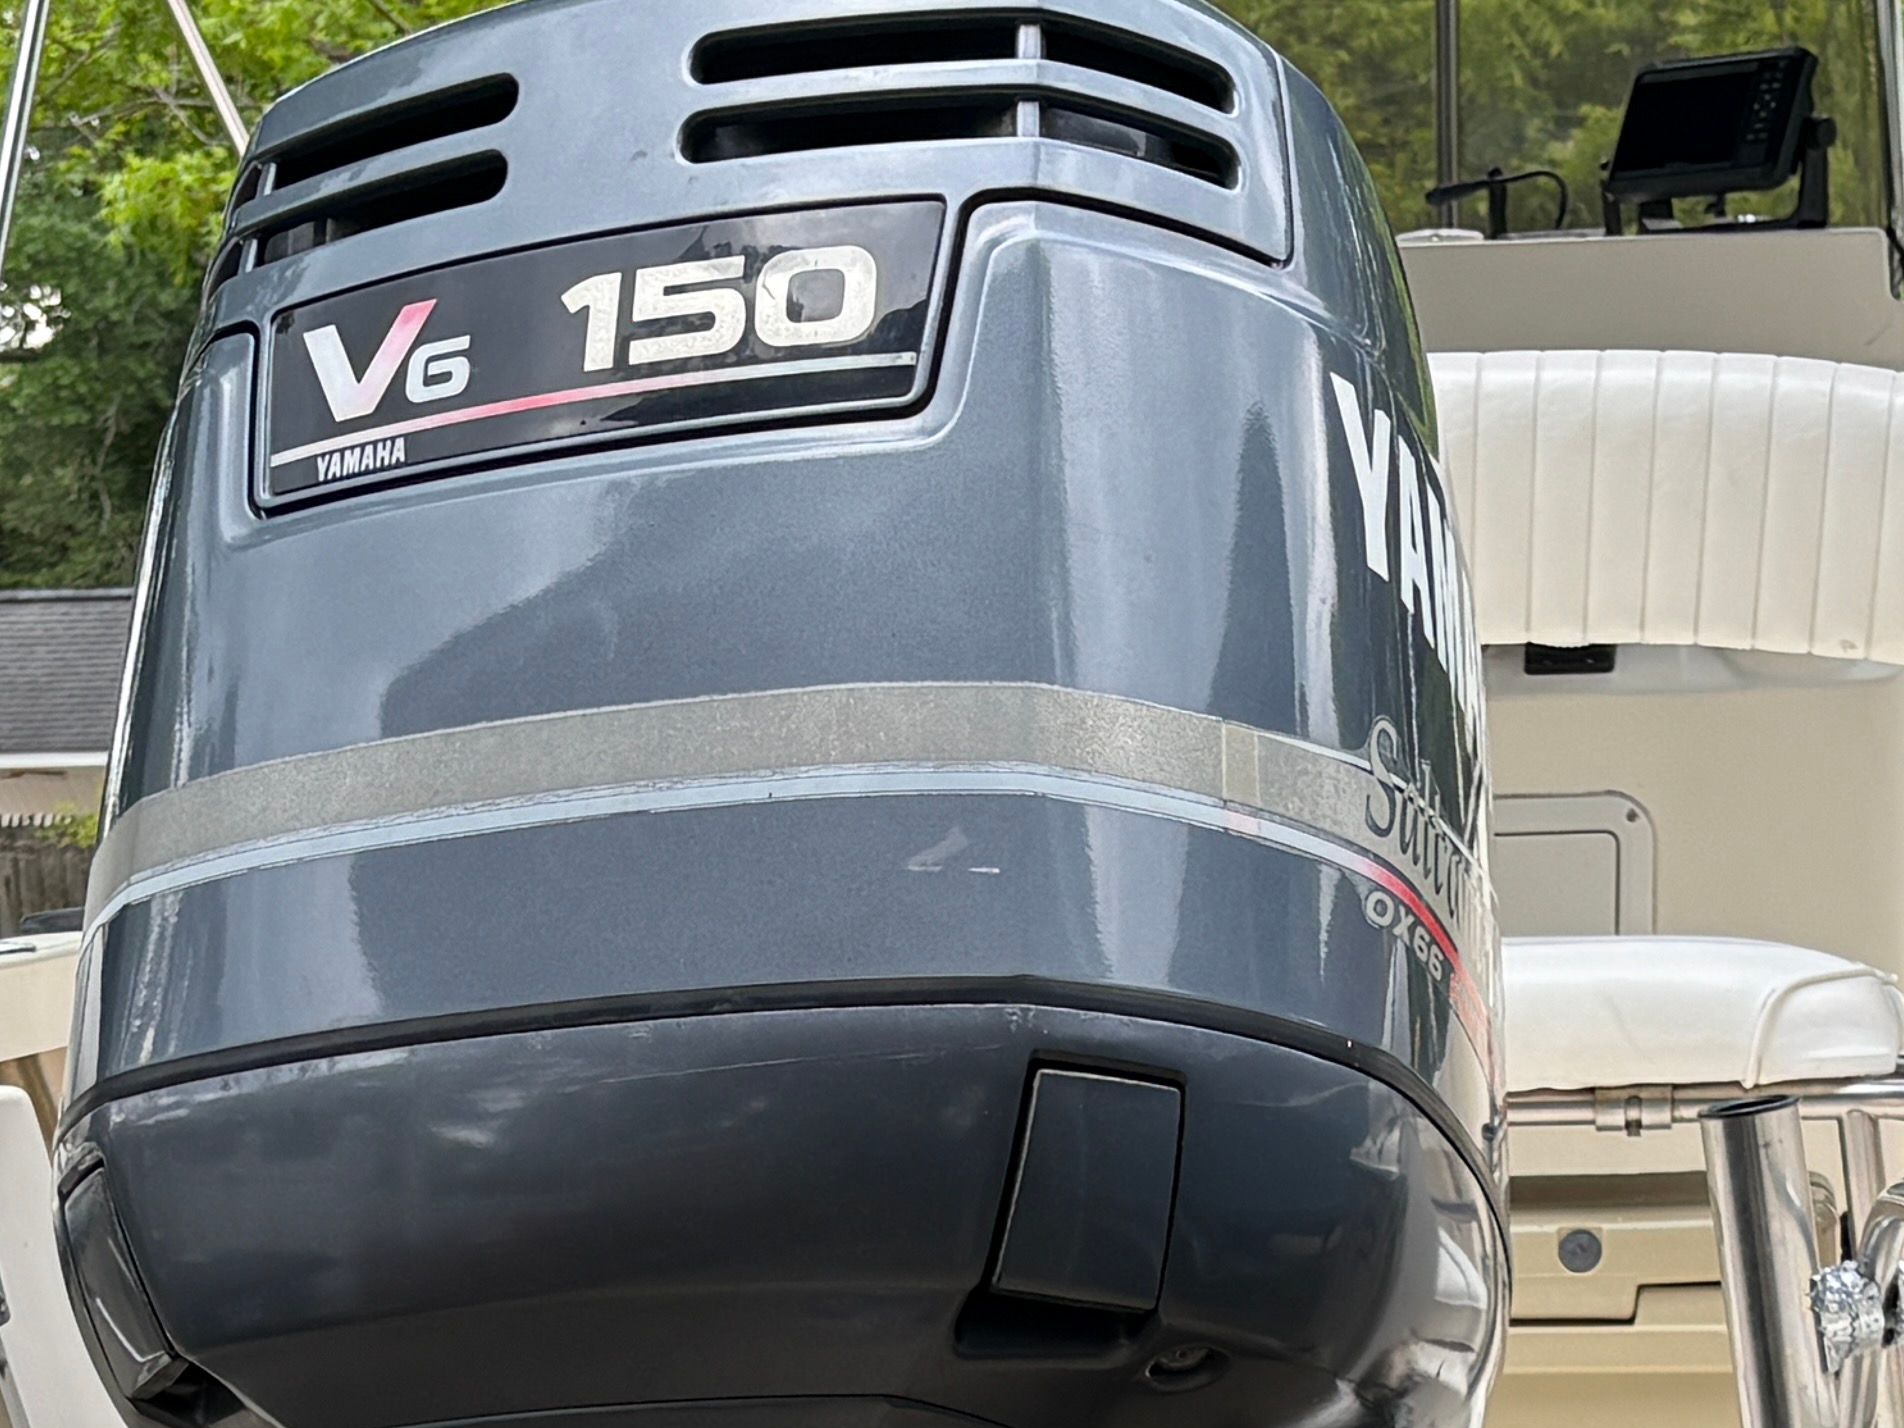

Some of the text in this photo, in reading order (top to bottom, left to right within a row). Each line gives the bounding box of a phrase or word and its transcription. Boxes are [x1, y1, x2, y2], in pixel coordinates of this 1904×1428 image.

[303, 244, 878, 423] V6 150
[315, 436, 407, 482] YAMAHA
[1365, 890, 1445, 982] OX66
